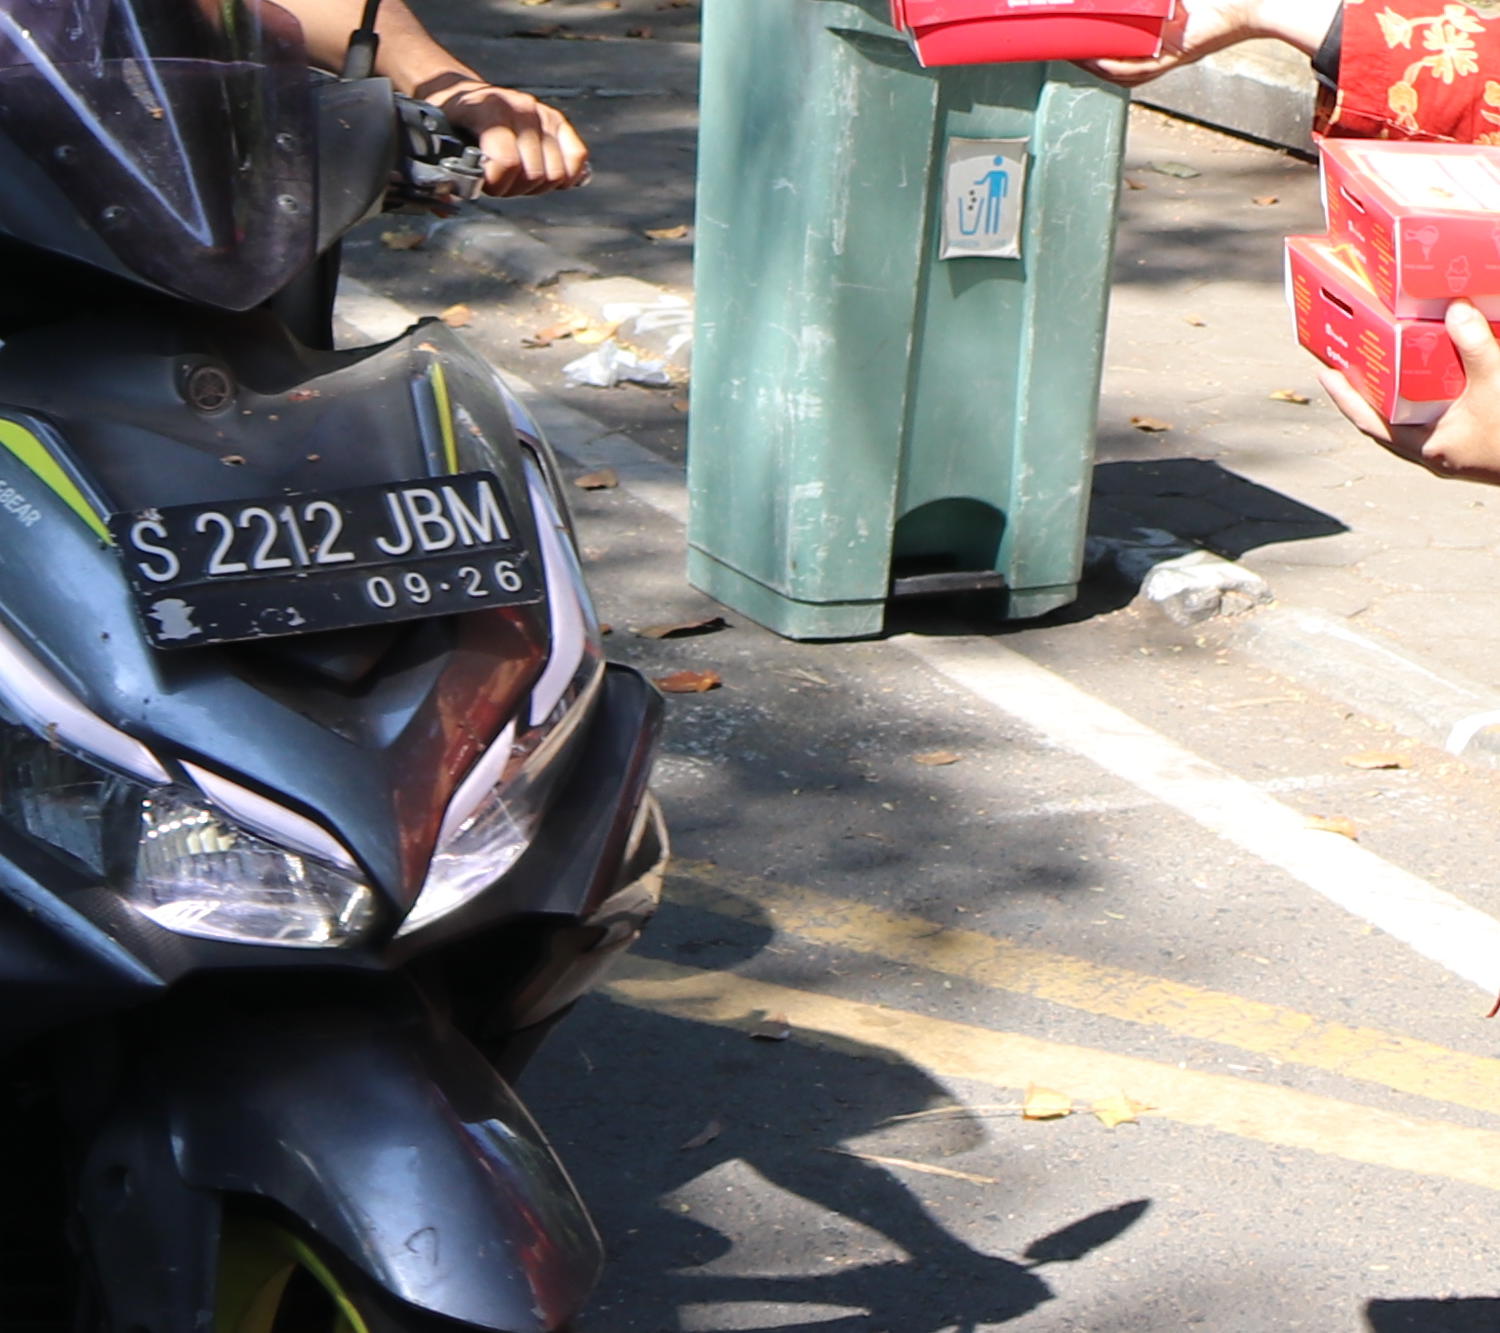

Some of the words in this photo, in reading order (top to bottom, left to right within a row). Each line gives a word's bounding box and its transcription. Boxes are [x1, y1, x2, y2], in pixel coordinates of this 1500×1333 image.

[130, 519, 180, 582] S
[195, 500, 355, 576] 2212
[376, 480, 511, 556] JBM
